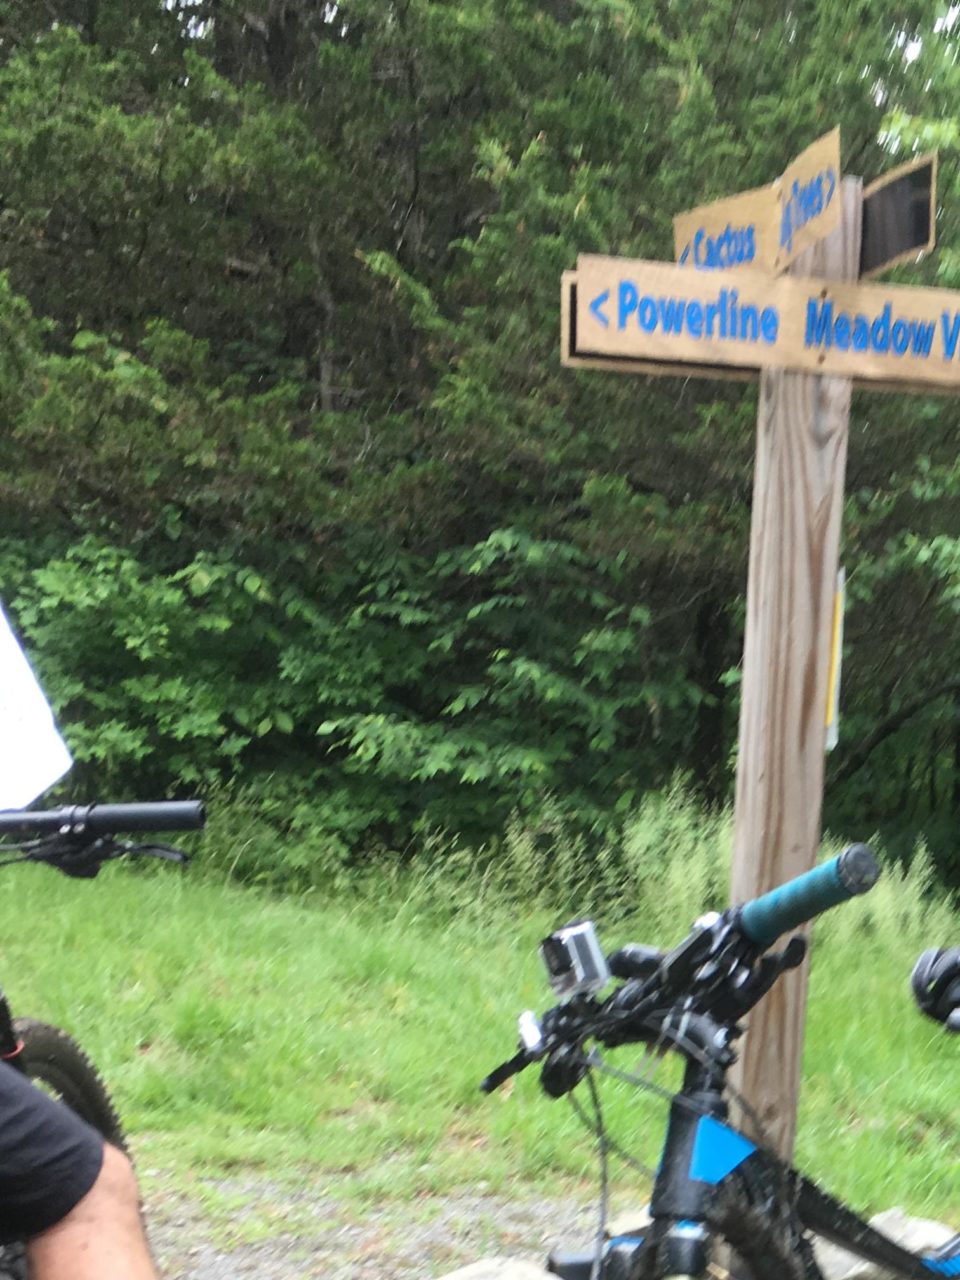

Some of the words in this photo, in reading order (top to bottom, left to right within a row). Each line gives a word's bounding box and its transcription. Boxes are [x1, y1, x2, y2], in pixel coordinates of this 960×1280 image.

[693, 223, 756, 271] Cactus
[616, 280, 780, 344] Powerline
[806, 297, 937, 356] Meadow
